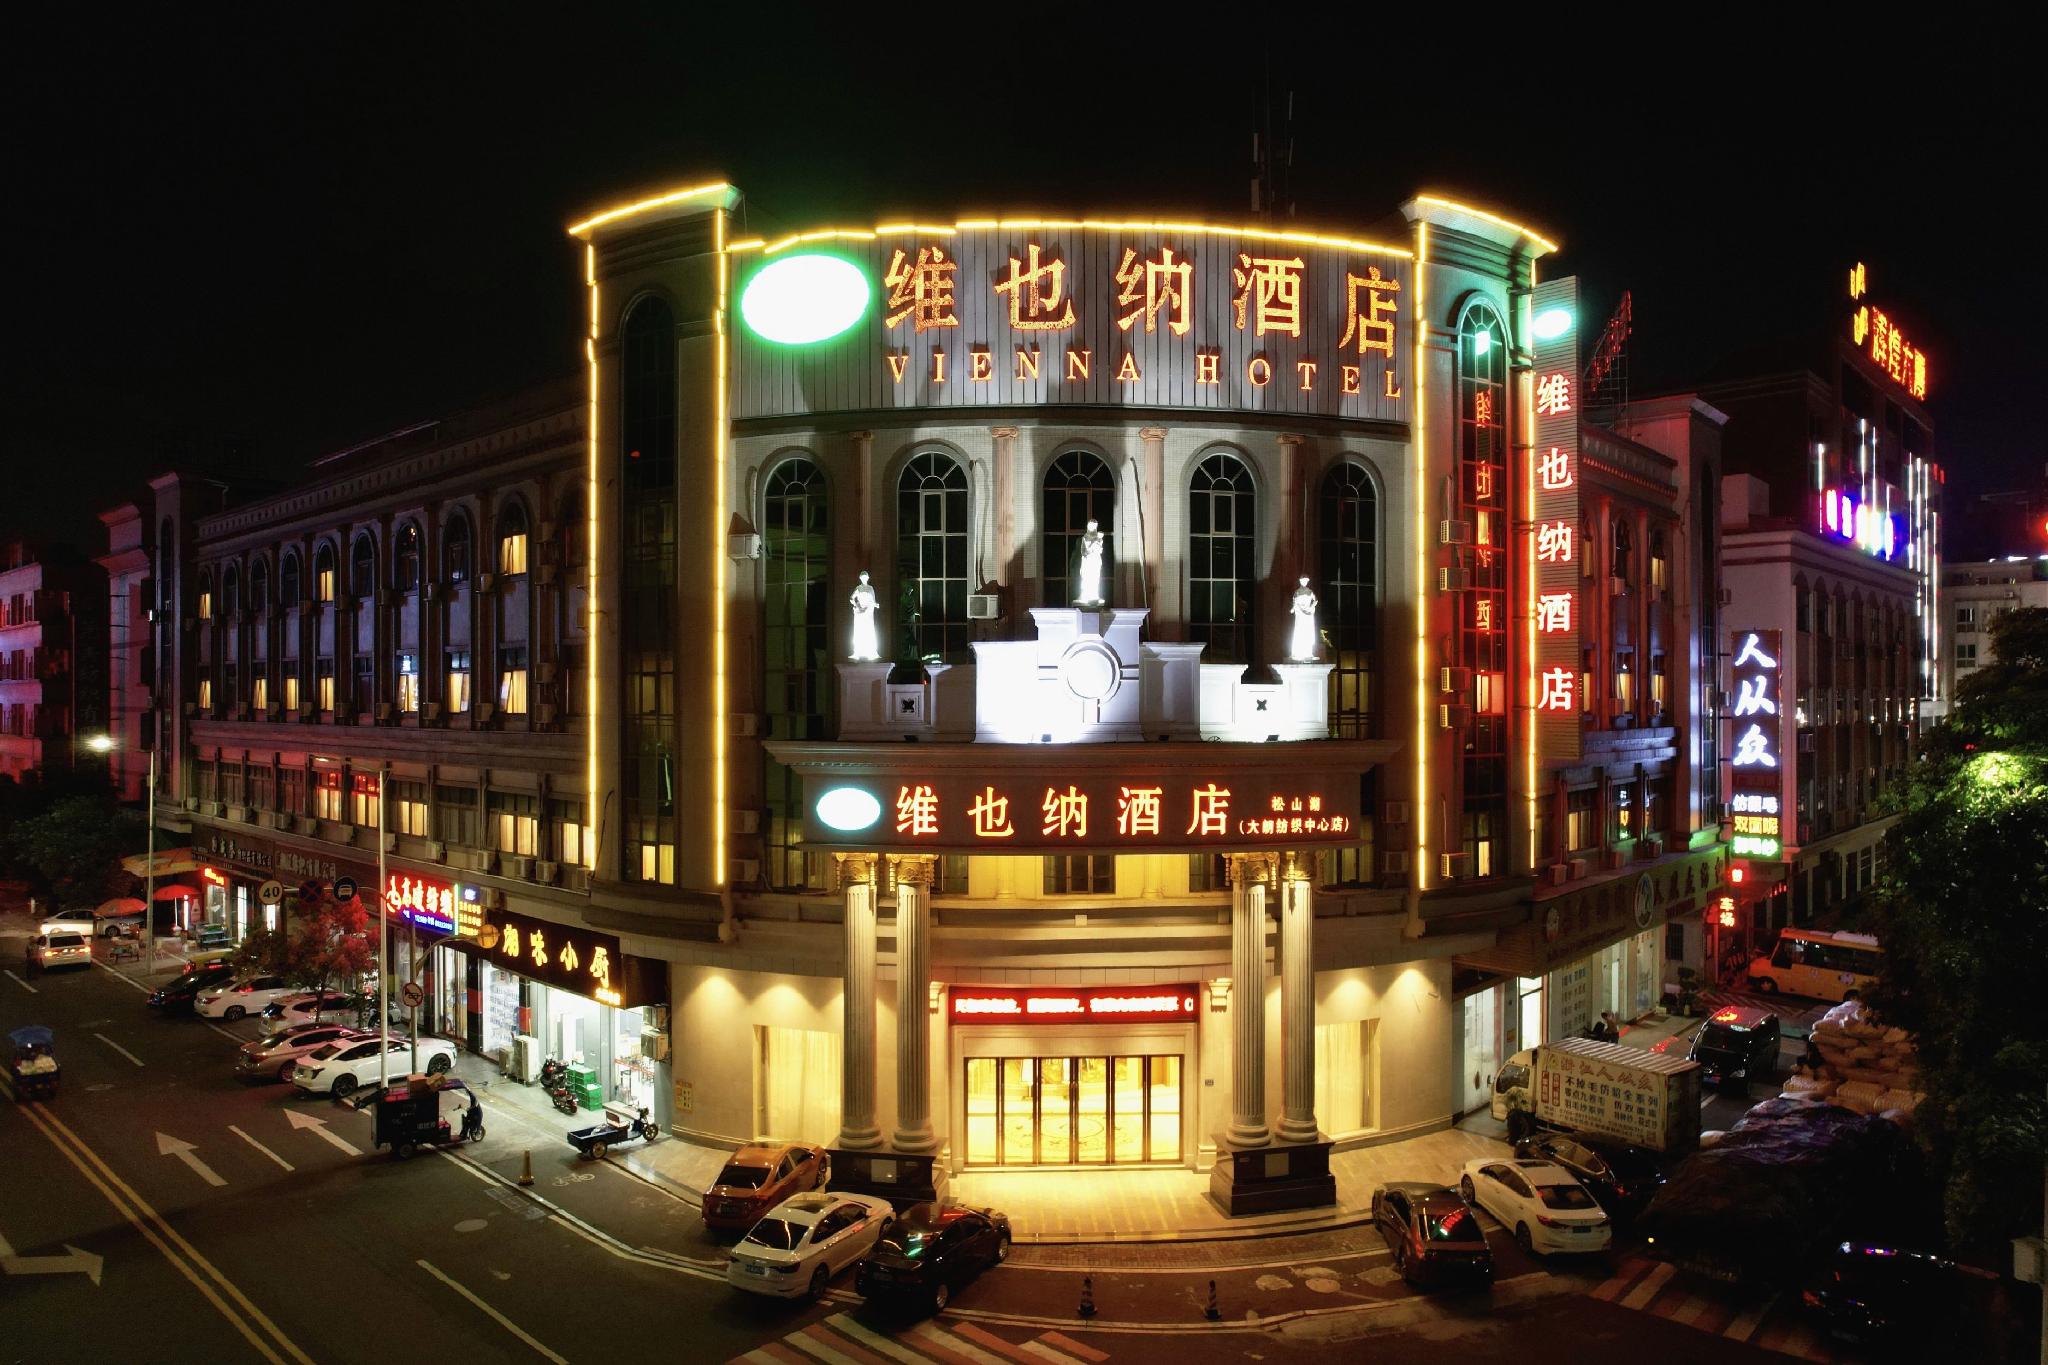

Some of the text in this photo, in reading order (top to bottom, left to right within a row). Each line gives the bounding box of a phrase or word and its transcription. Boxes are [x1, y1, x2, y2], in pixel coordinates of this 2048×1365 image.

[884, 244, 1402, 360] 维也纳酒店
[888, 349, 1402, 399] VIENNA HOTEL
[1536, 373, 1574, 712] 维也纳酒店
[1733, 633, 1777, 767] 人从众
[895, 784, 1231, 837] 维也纳酒店
[1734, 815, 1778, 834] 双面呢
[263, 886, 280, 899] 40
